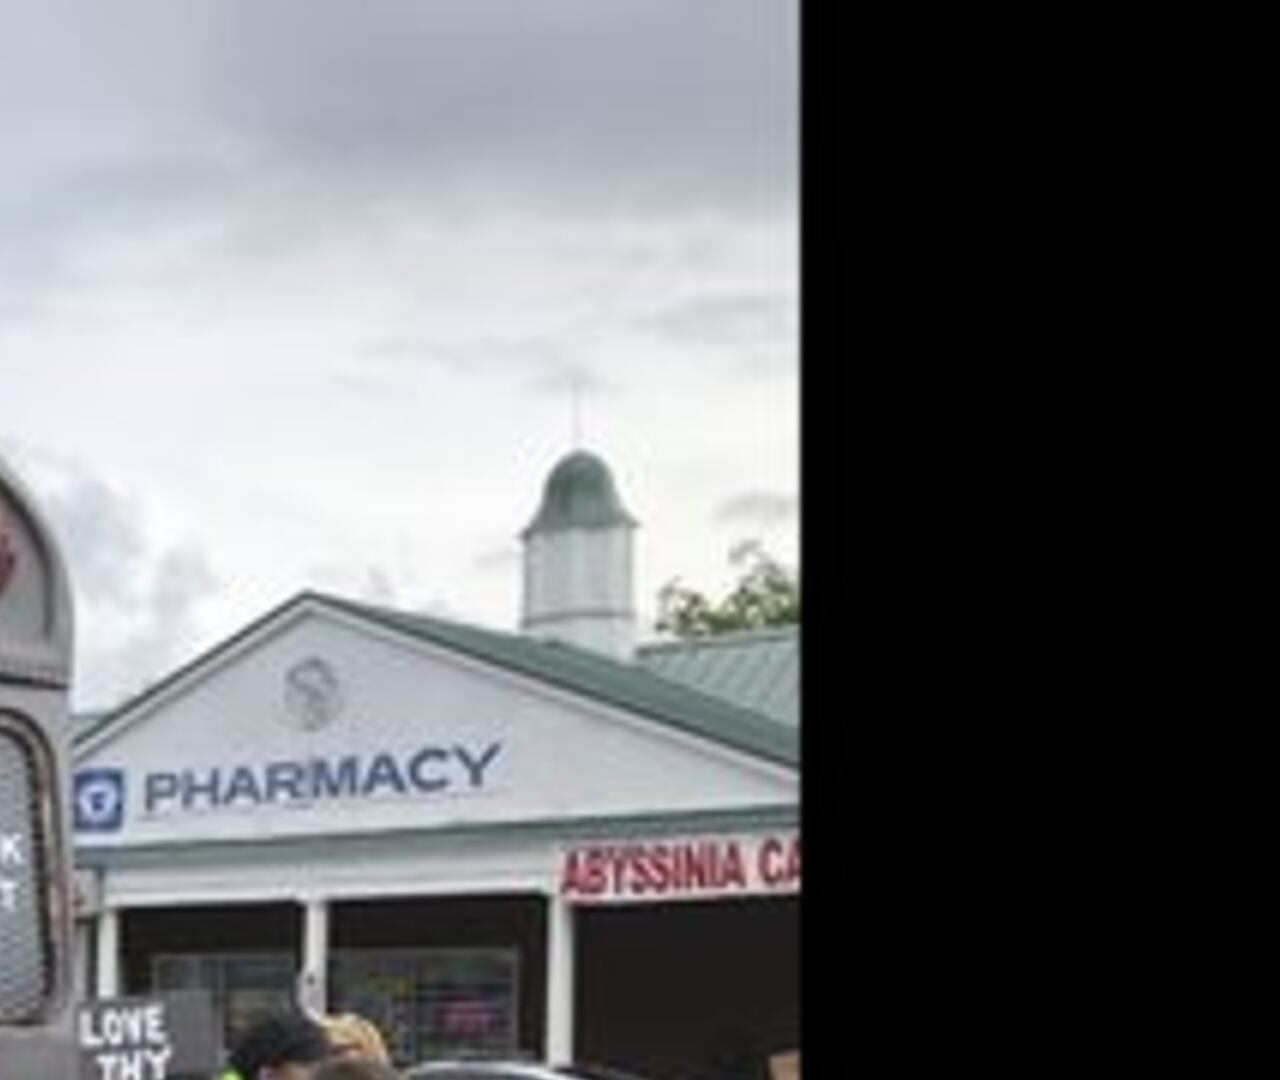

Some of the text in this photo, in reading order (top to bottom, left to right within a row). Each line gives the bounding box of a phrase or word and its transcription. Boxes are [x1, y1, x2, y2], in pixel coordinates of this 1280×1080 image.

[144, 743, 501, 811] PHARMACY
[561, 838, 745, 895] ABYSSINIA
[79, 1006, 168, 1047] LOVE
